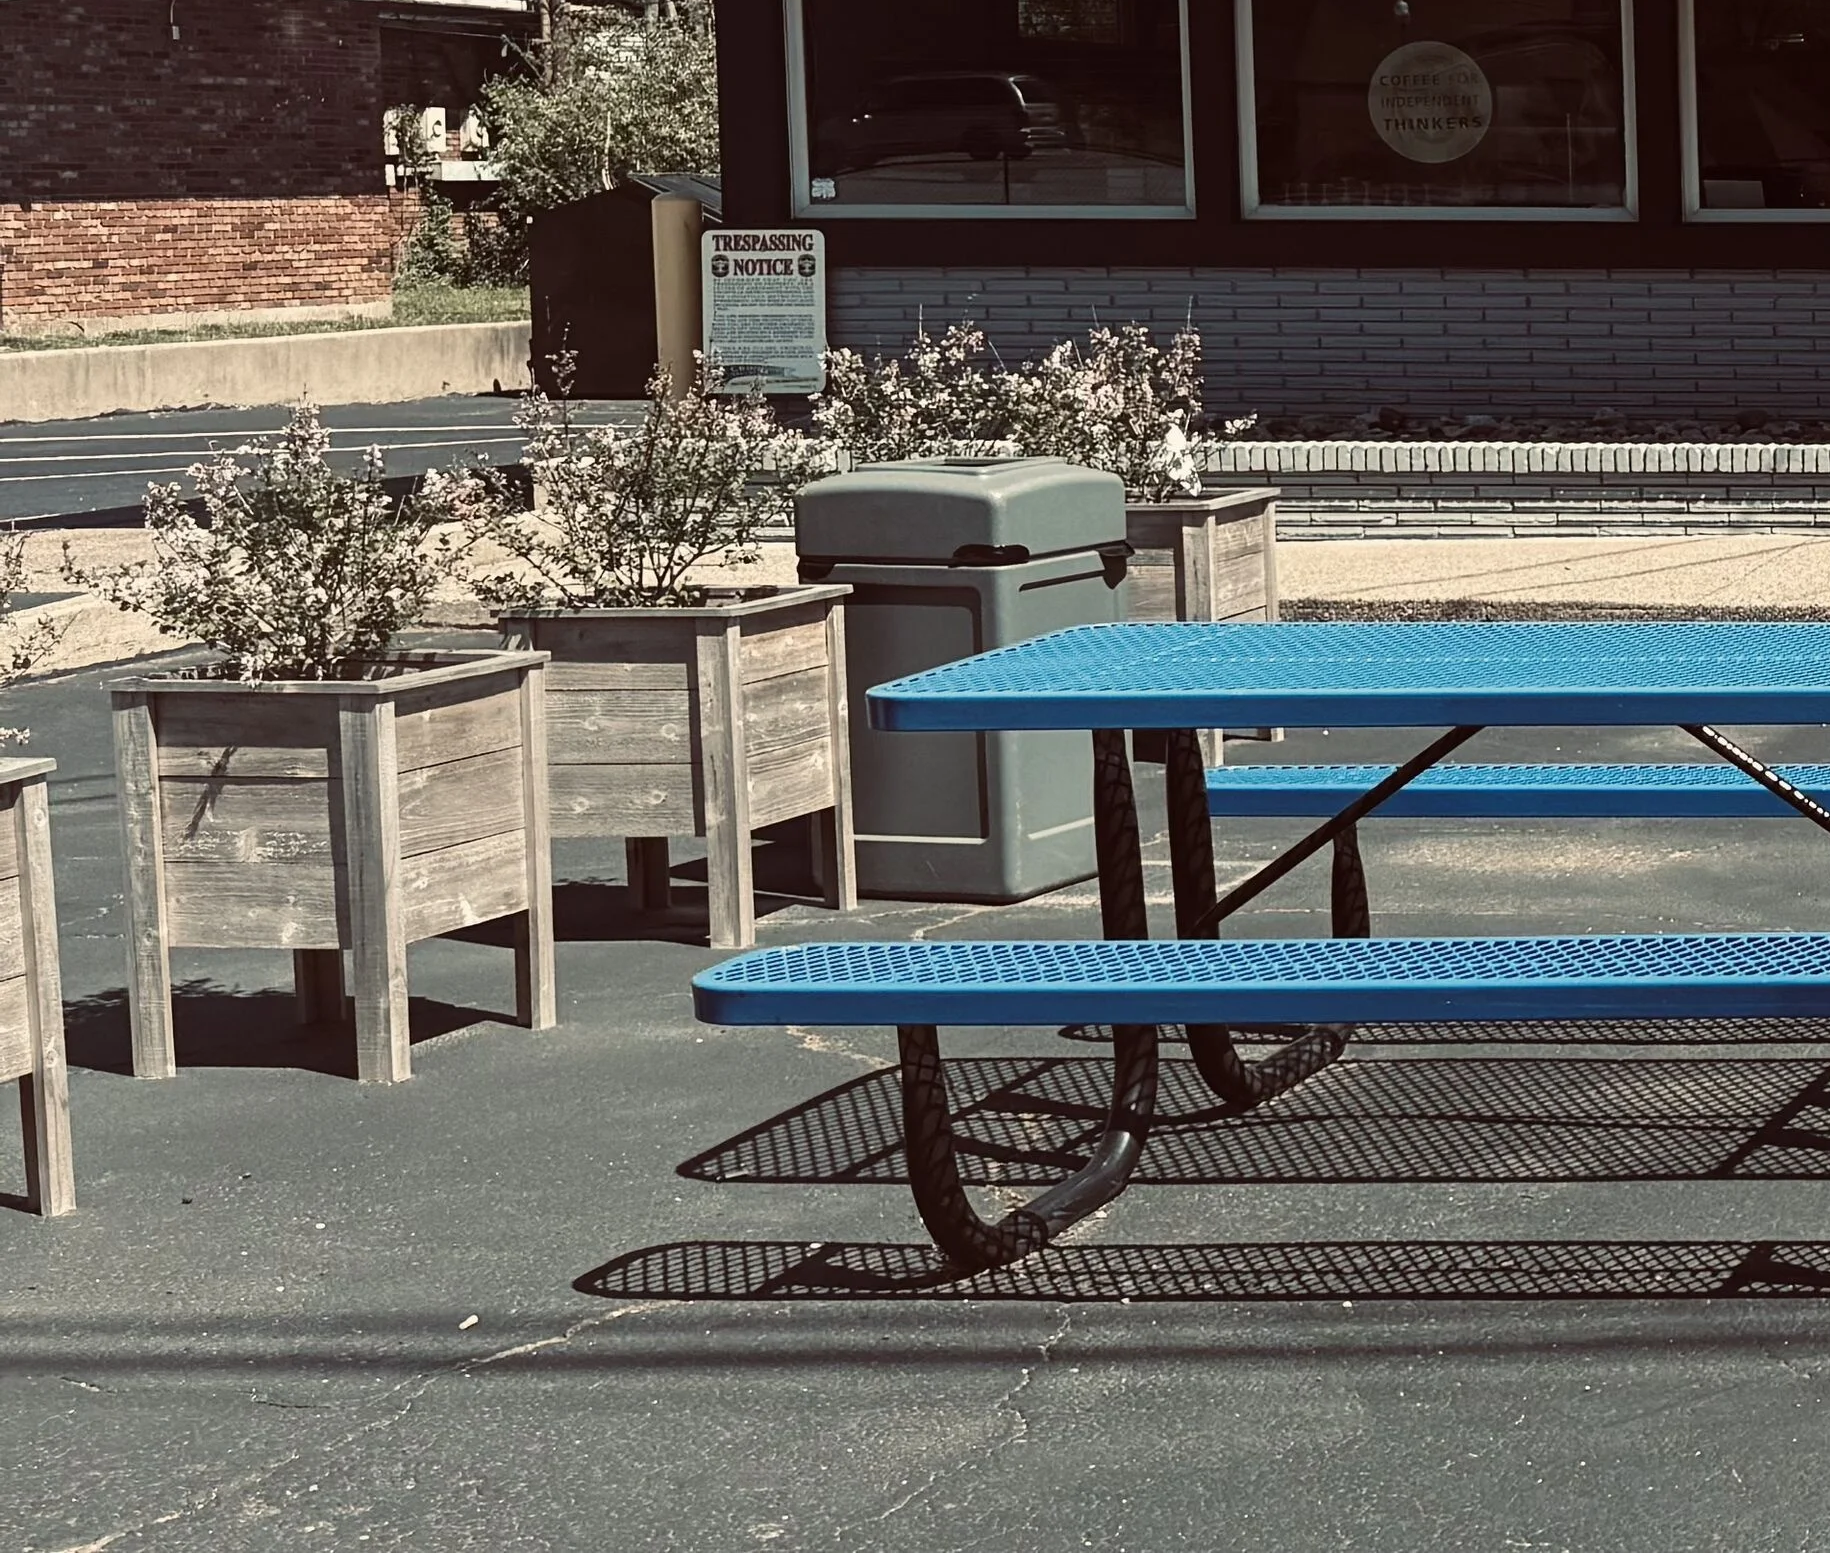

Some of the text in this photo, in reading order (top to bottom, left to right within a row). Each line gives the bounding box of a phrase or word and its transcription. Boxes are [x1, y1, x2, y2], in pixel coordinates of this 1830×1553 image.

[1380, 72, 1479, 86] COFFEE FOR
[1381, 94, 1479, 108] INDEPENDENT
[1384, 116, 1482, 131] THINKERS
[712, 234, 814, 252] TRESPASSING
[733, 258, 794, 276] NOTICE
